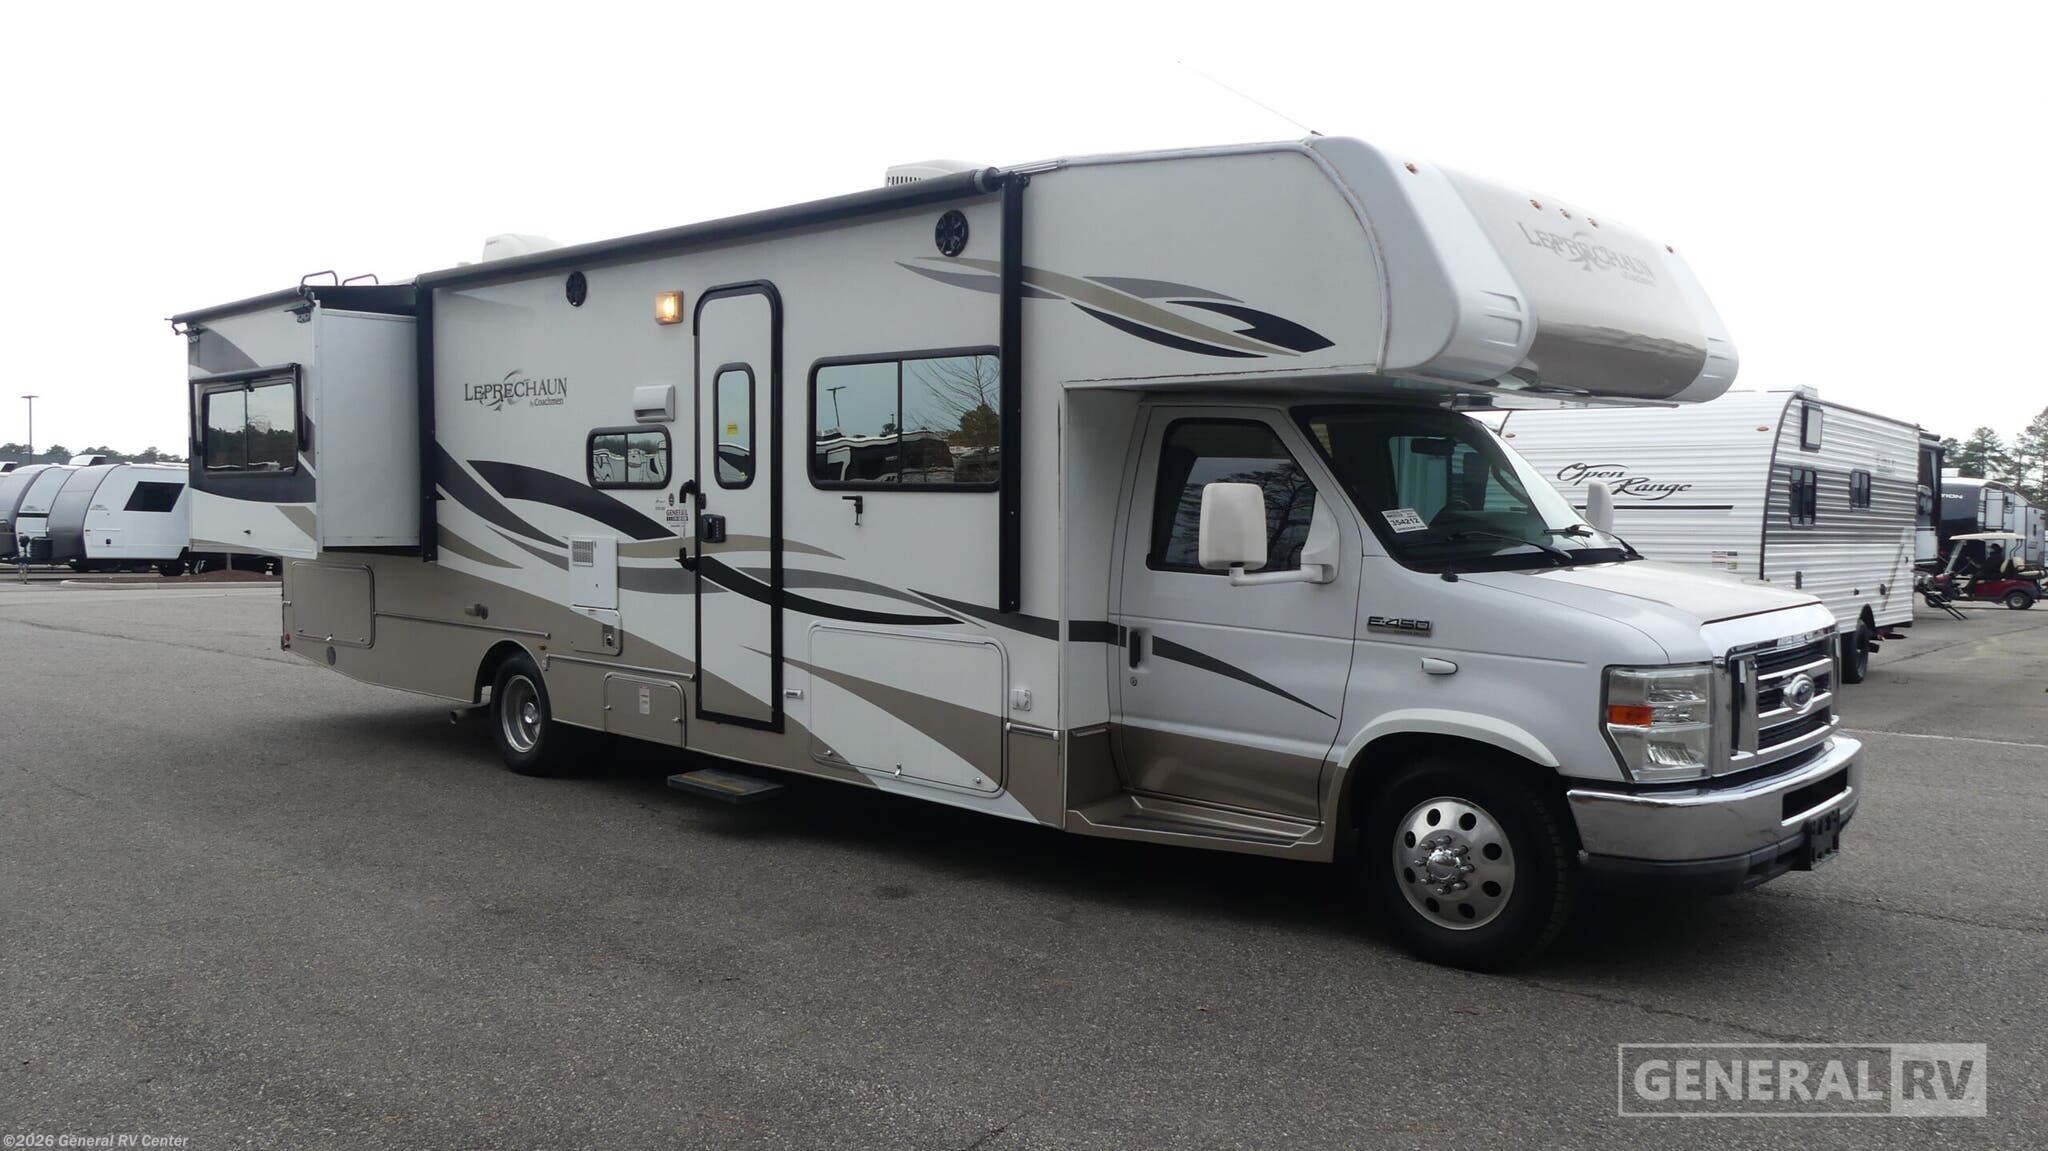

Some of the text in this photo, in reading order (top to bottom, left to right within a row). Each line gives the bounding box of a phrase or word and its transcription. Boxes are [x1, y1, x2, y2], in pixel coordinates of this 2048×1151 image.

[1515, 220, 1656, 280] LEPRECHAUN
[464, 377, 567, 403] LEPRECHAUN
[534, 398, 564, 407] Coachmen
[1557, 462, 1629, 486] Open
[1608, 477, 1692, 501] Range
[1390, 518, 1420, 526] 354212
